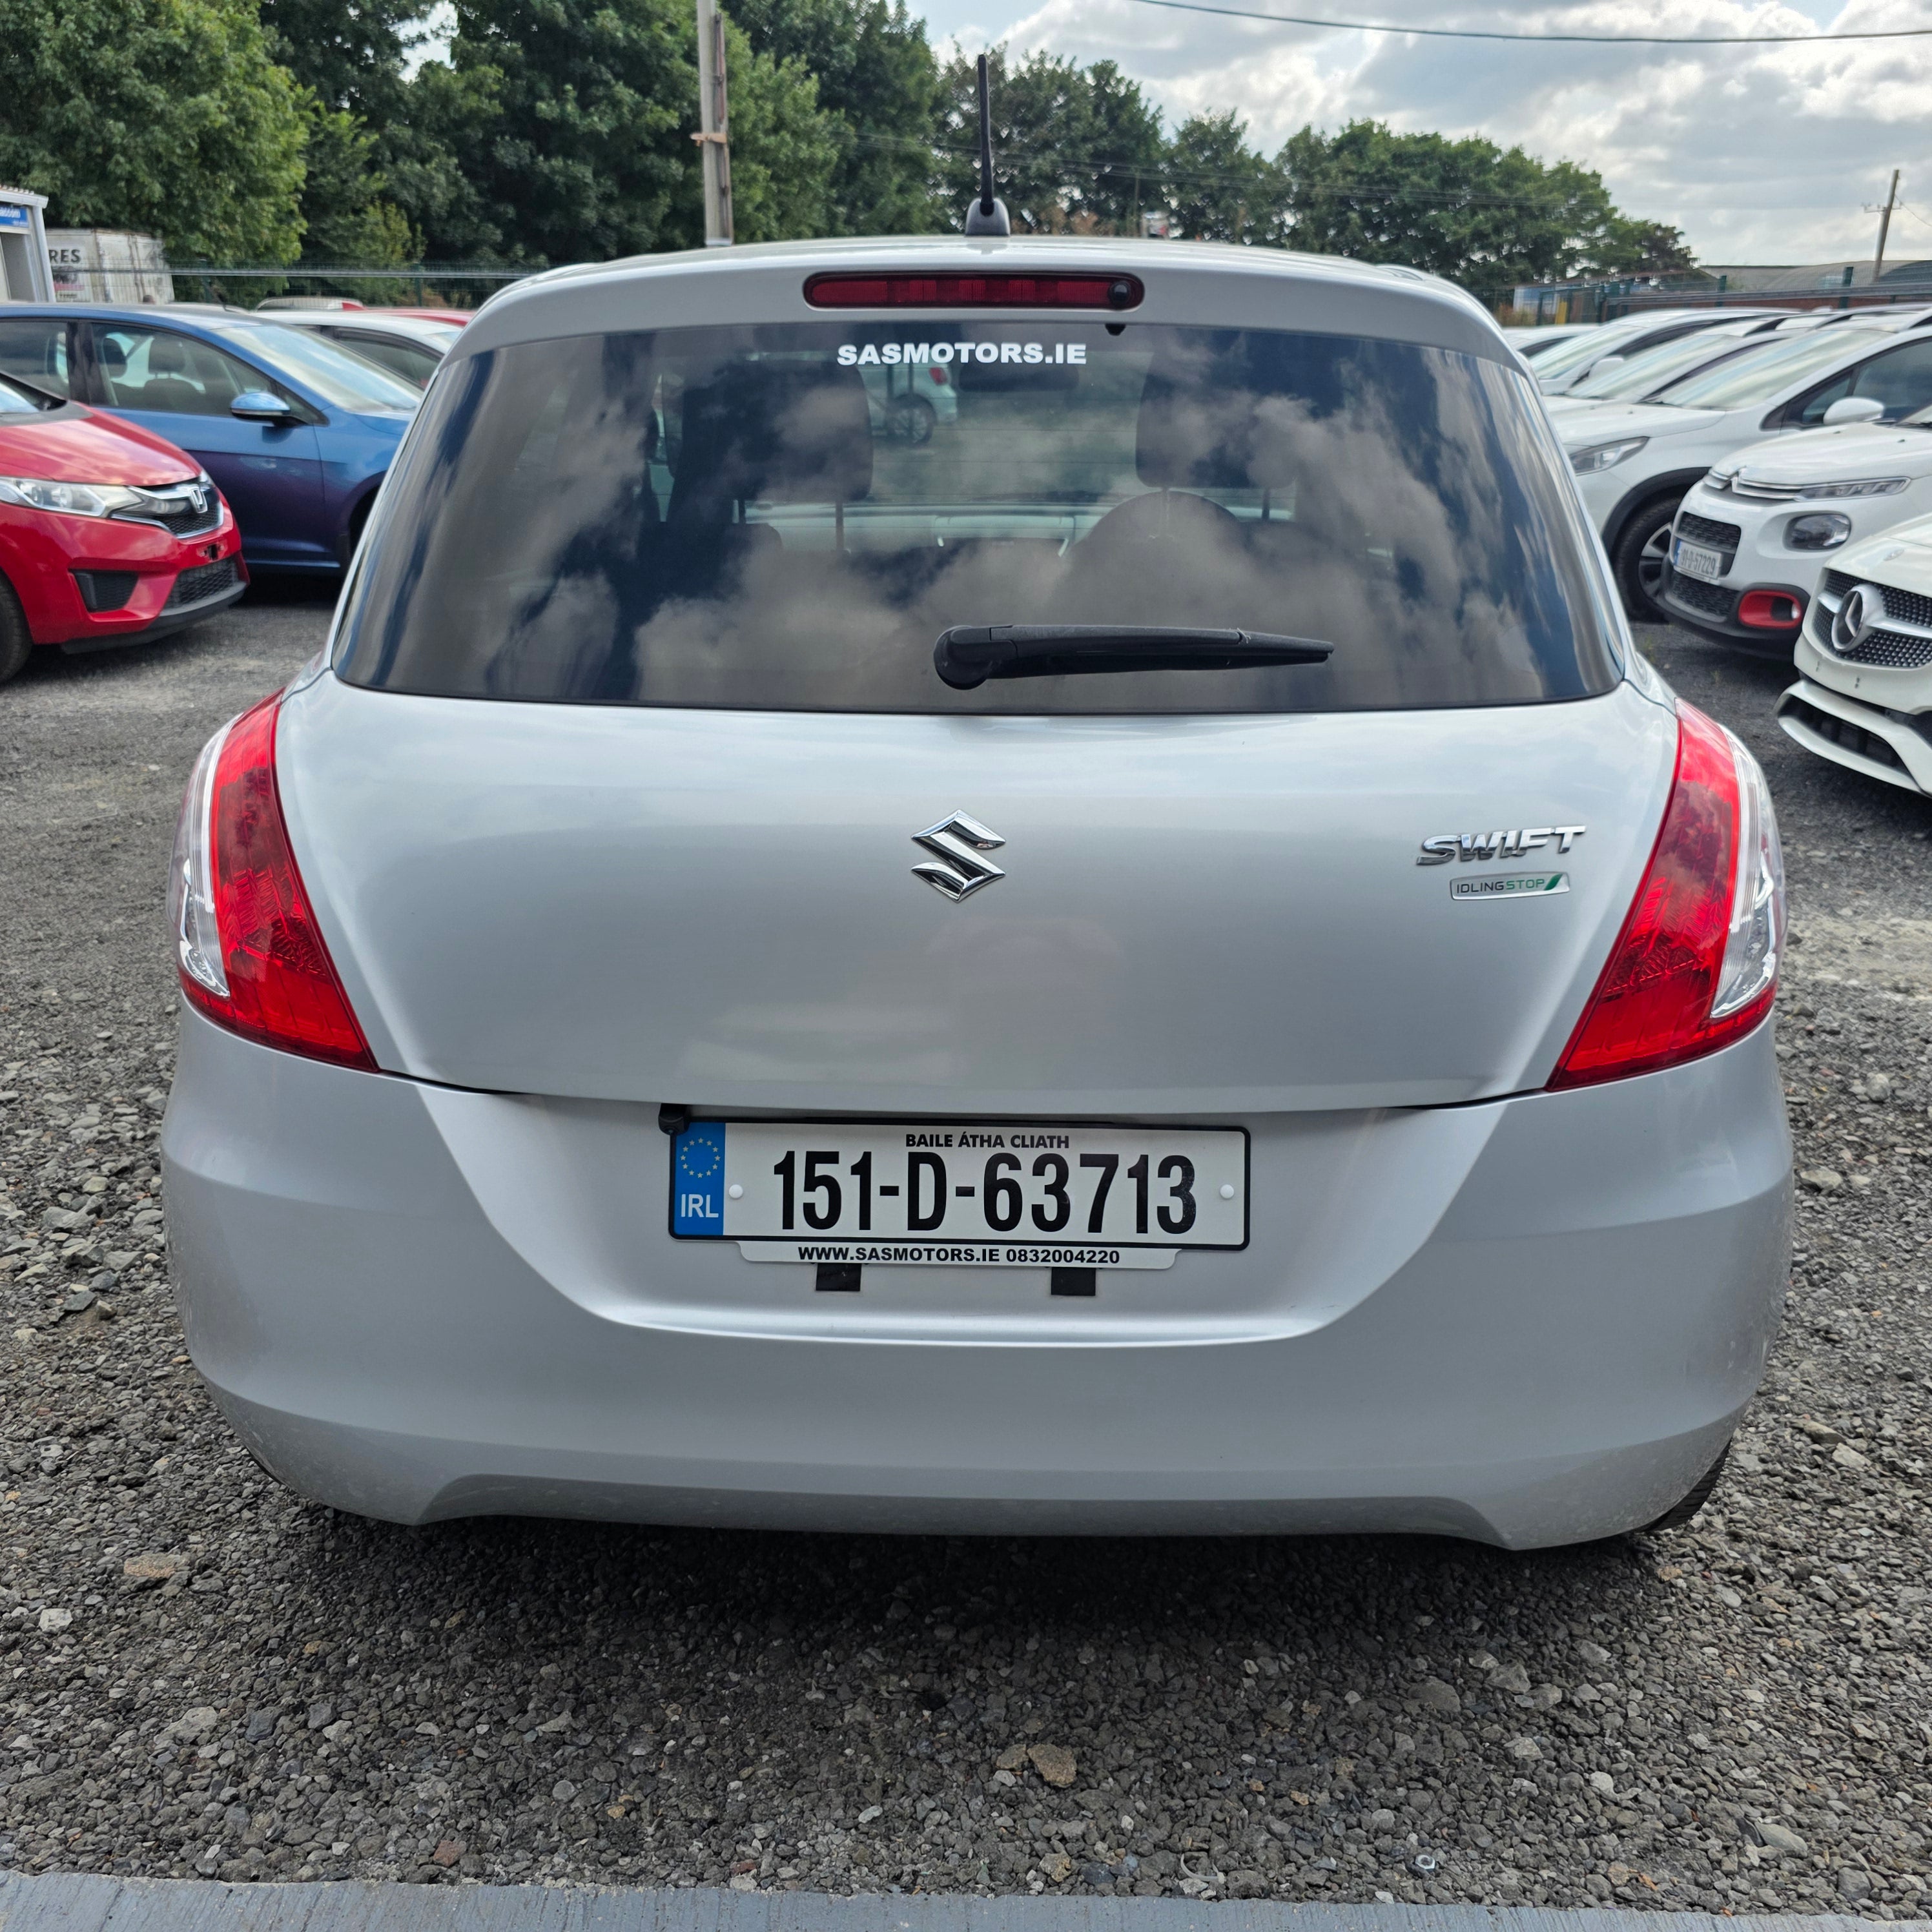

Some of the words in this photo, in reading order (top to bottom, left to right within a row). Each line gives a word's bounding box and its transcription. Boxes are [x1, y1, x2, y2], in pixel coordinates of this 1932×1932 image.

[837, 342, 1087, 365] SASMOTORS.IE
[1416, 825, 1587, 866] SWIFT
[905, 1134, 953, 1147] BAILE
[958, 1131, 1005, 1148] ÁTHA
[1010, 1135, 1069, 1149] CLIATH
[774, 1150, 1196, 1235] 151-D-63713
[681, 1194, 719, 1218] IRL
[797, 1246, 1000, 1262] WWW.SASMOTORS.IE
[1006, 1249, 1120, 1264] 0832004220
